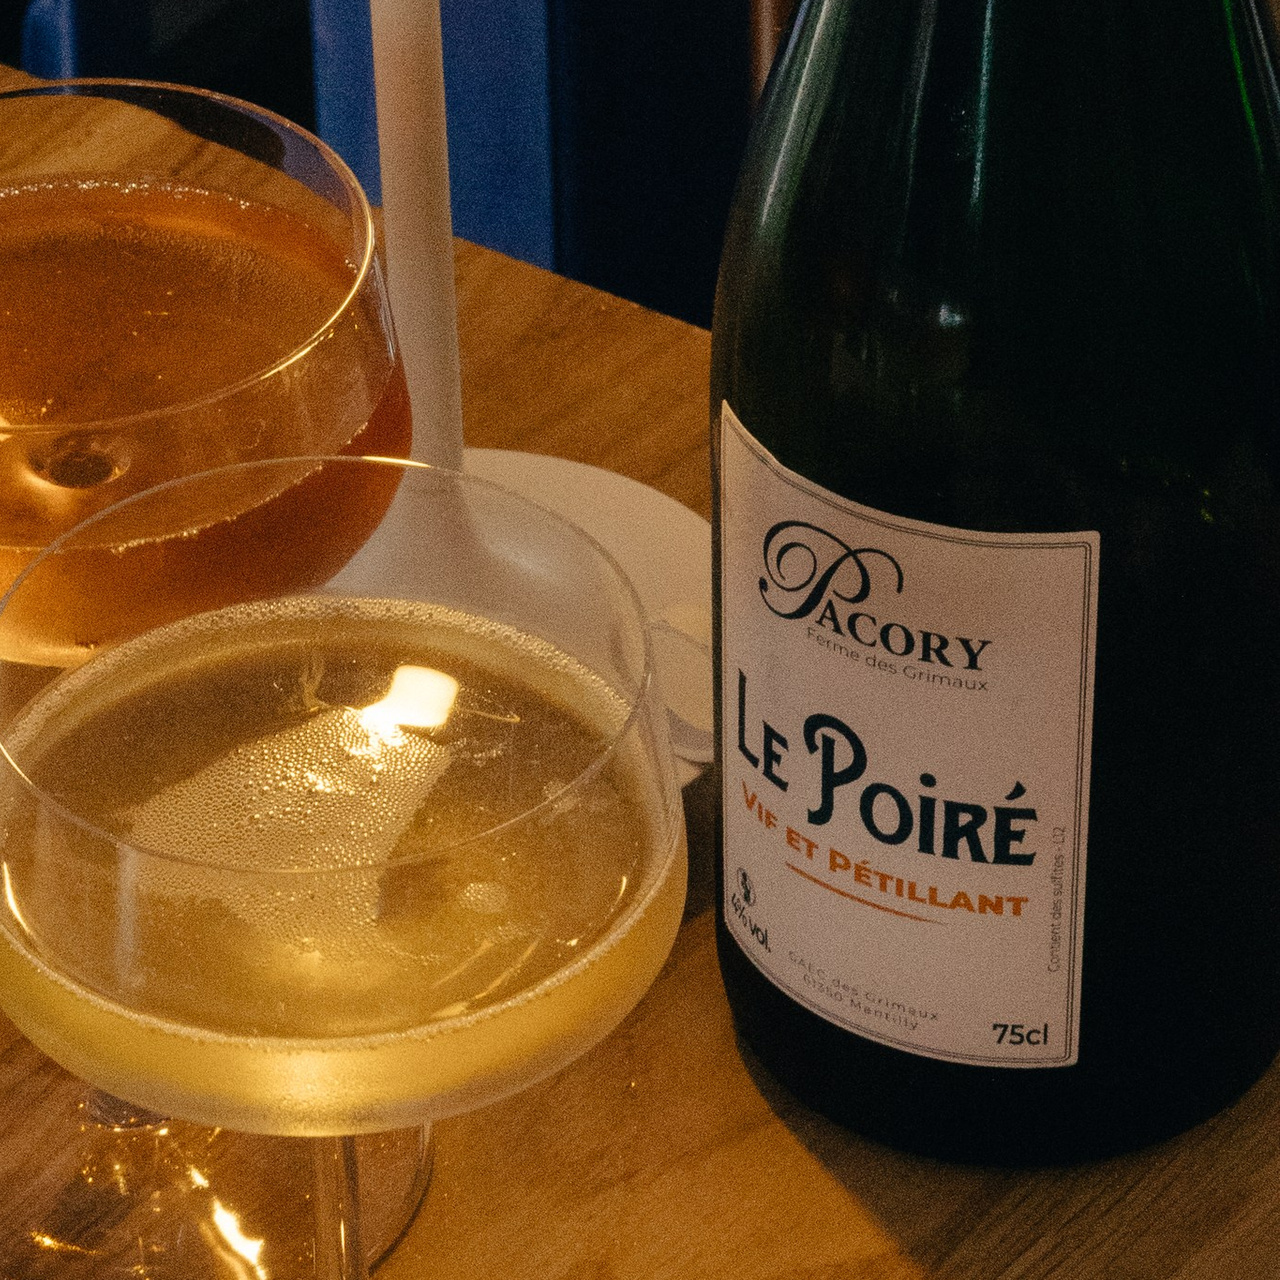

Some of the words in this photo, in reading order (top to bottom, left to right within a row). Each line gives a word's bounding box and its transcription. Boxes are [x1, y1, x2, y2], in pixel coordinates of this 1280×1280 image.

[759, 520, 992, 671] PACORY
[806, 626, 860, 662] Ferme
[865, 654, 898, 676] des
[903, 662, 989, 692] Grimaux
[741, 779, 778, 829] VIF
[785, 825, 819, 860] ET
[829, 846, 1030, 917] PÉTILLANT
[1051, 897, 1063, 921] des
[991, 1023, 1049, 1046] 75cl
